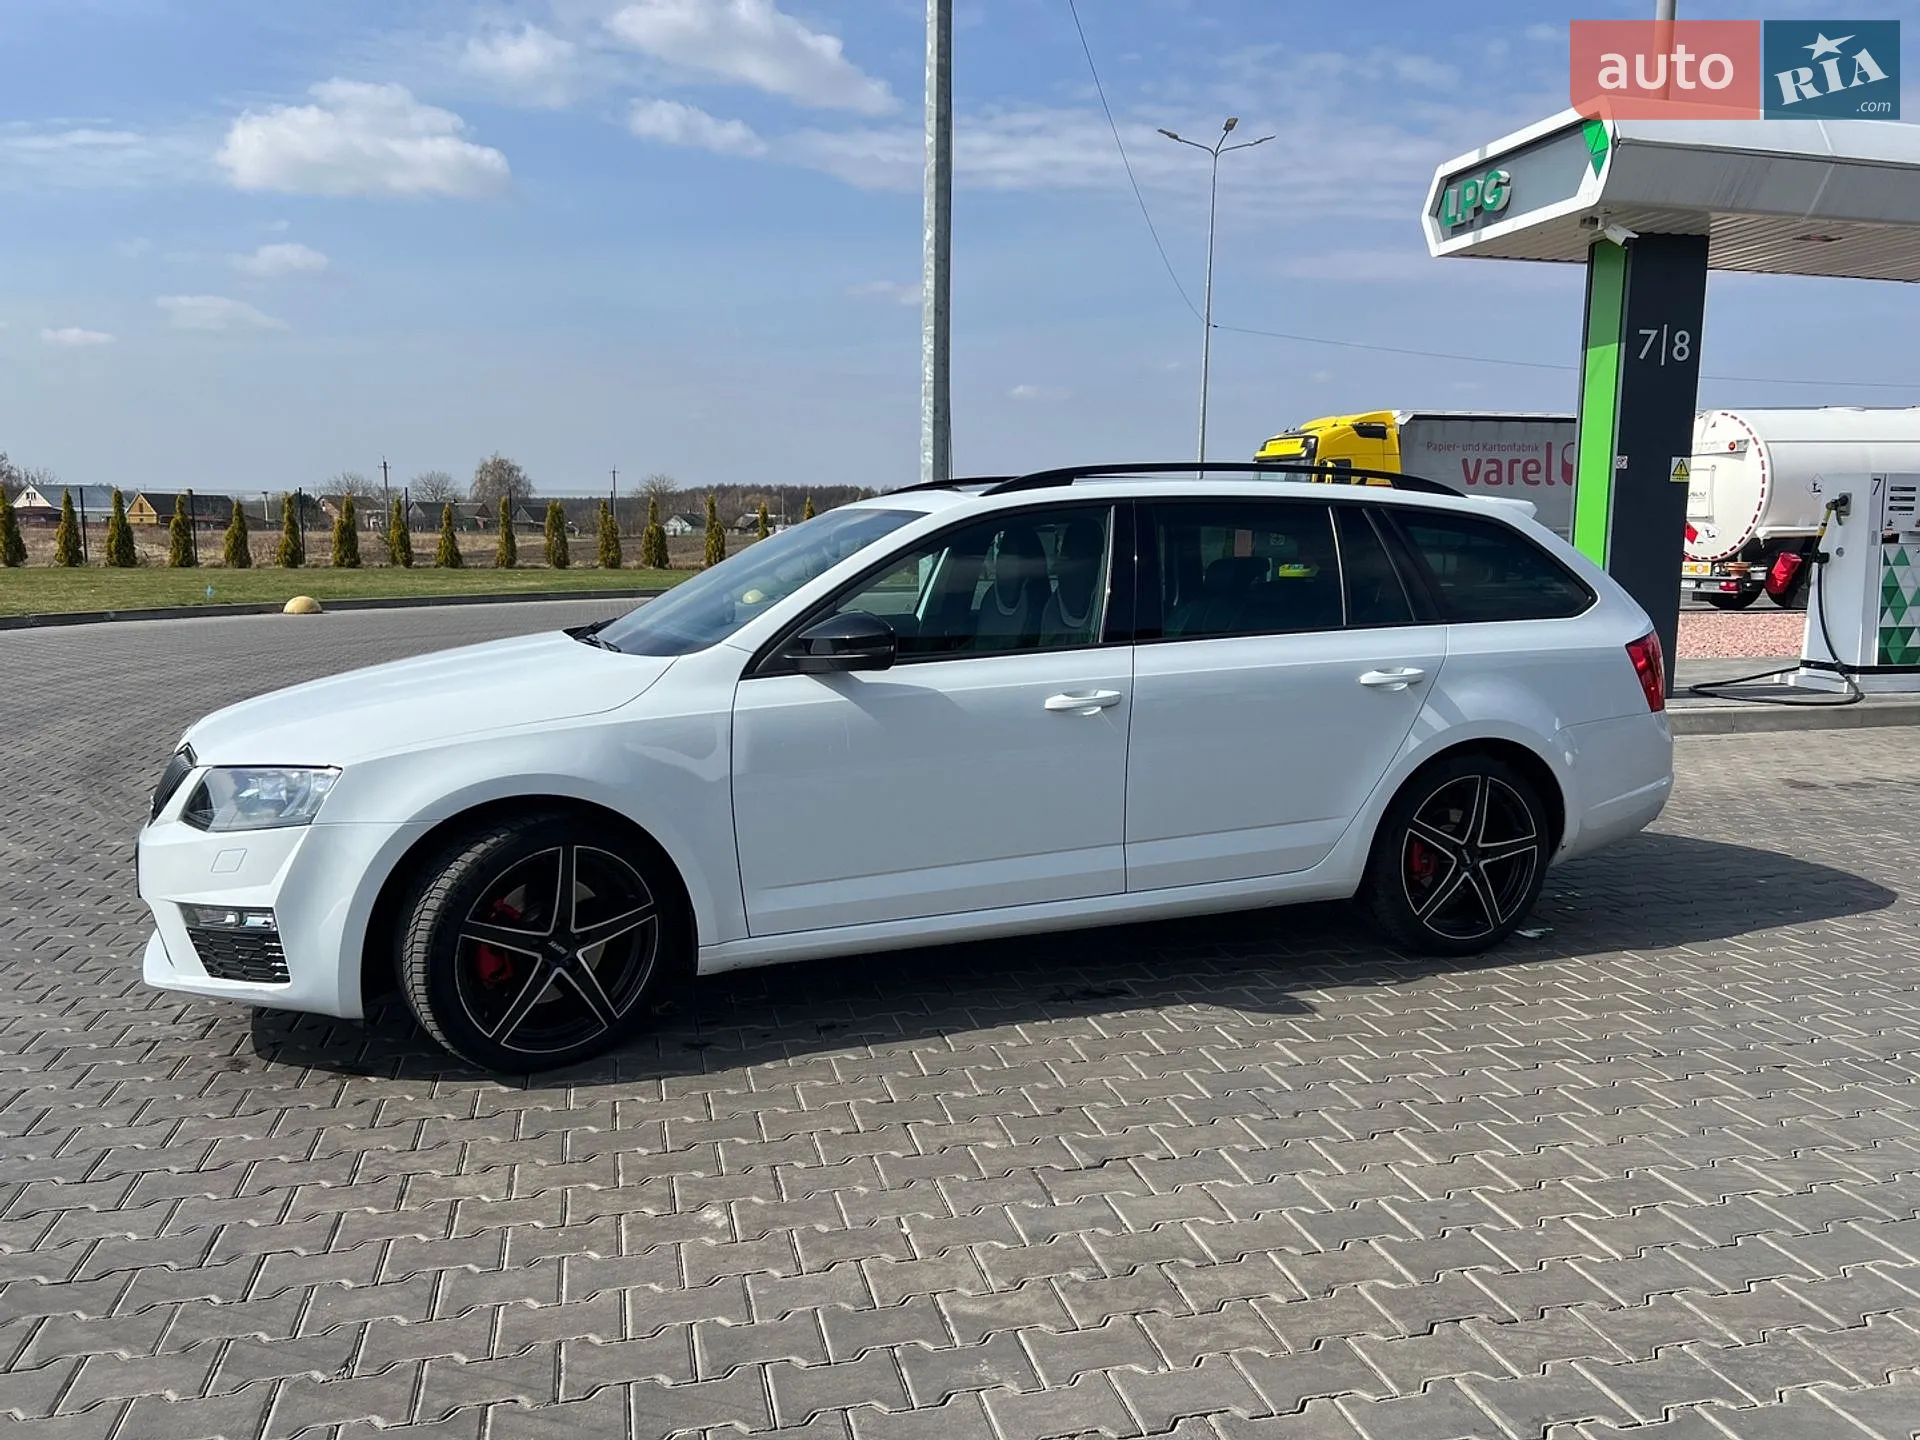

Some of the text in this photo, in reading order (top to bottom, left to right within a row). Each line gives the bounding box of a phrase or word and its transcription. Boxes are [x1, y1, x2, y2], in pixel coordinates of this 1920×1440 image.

[1443, 170, 1511, 228] LPG
[1426, 441, 1539, 453] Papier- und Kartonfabrik
[1461, 441, 1556, 486] varel
[1872, 478, 1881, 496] 7
